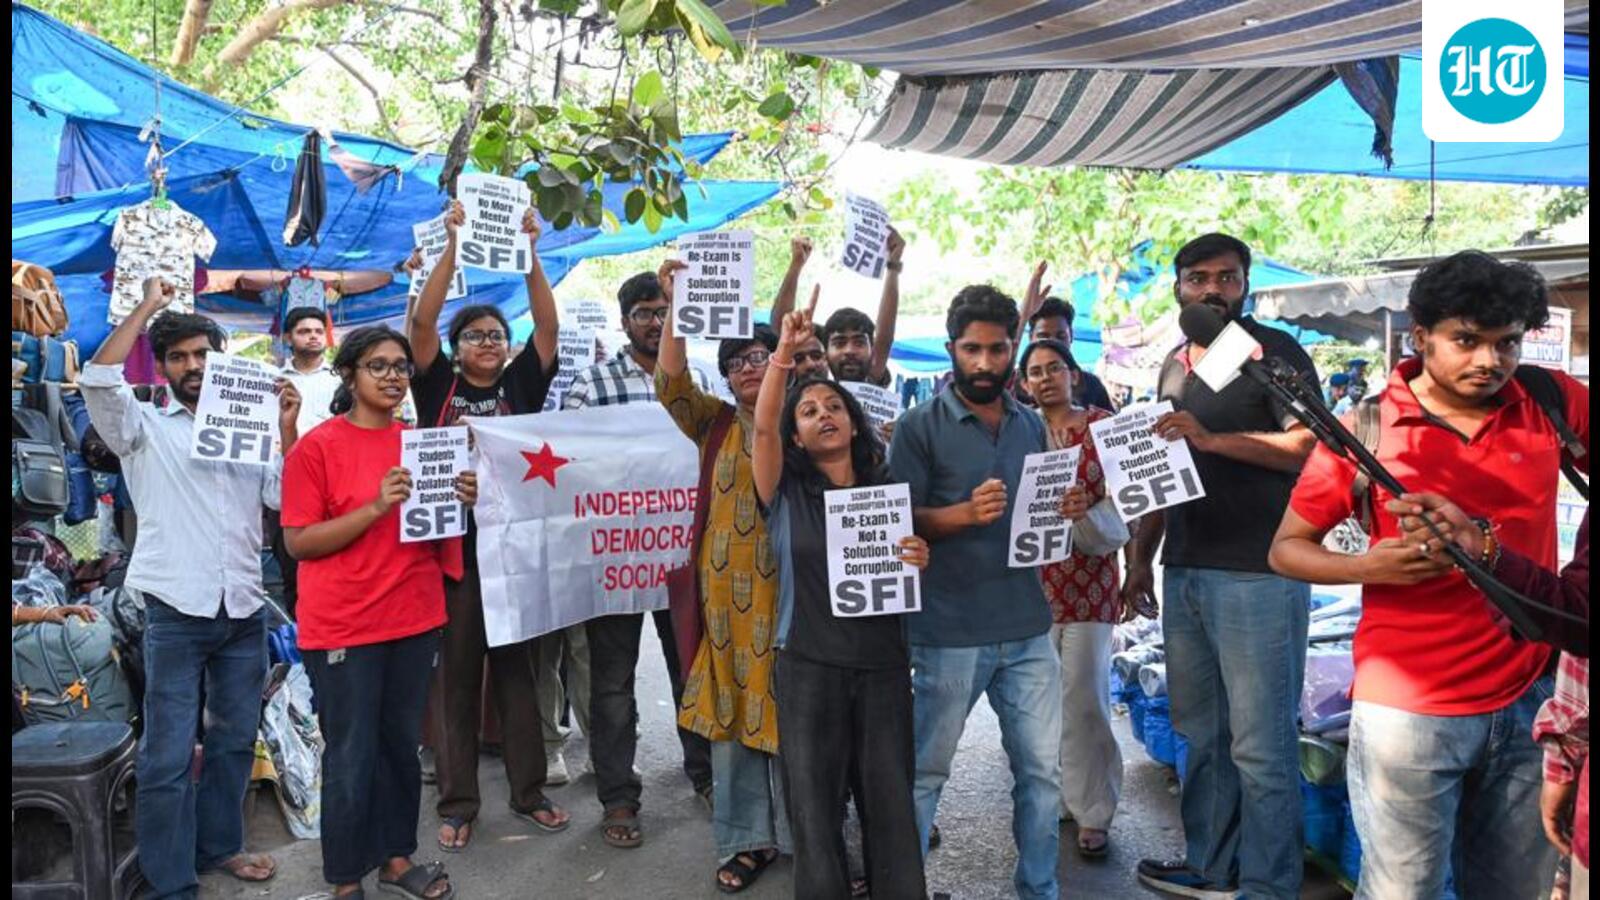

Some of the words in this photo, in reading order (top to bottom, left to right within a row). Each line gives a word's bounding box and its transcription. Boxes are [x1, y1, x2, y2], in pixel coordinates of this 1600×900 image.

[478, 198, 488, 208] No
[491, 200, 513, 213] More
[480, 210, 510, 224] Mental
[472, 220, 501, 233] Torture
[504, 225, 516, 236] for
[472, 232, 514, 246] Aspirants
[461, 241, 525, 270] SFI
[688, 251, 729, 262] Re-Exam
[732, 251, 741, 262] Is
[843, 243, 884, 278] SFI
[702, 265, 717, 275] Not
[720, 266, 726, 275] a
[687, 278, 727, 289] Solution
[730, 278, 740, 288] to
[688, 292, 739, 303] Corruption
[678, 306, 749, 335] SFI
[561, 345, 589, 356] Playing
[212, 374, 234, 388] Stop
[237, 378, 280, 394] Treating
[220, 389, 264, 404] Students
[543, 391, 567, 411] SF
[229, 403, 250, 415] Like
[206, 415, 269, 431] Experiments
[196, 428, 272, 462] SFI
[1104, 434, 1128, 449] Stop
[1130, 428, 1152, 440] Play
[1128, 440, 1152, 455] With
[418, 450, 454, 462] Students
[422, 466, 436, 476] Are
[439, 464, 452, 474] Not
[1128, 461, 1170, 482] Futures
[417, 478, 456, 490] Collatera
[1036, 472, 1072, 486] Students
[420, 492, 454, 504] Damage
[1035, 489, 1050, 499] Are
[1118, 468, 1199, 515] SFI
[574, 488, 698, 518] INDEPENDE
[829, 504, 845, 514] STOP
[847, 501, 885, 512] CORRUPTION
[405, 504, 466, 537] SFI
[842, 513, 888, 528] Re-Exam
[890, 512, 900, 524] Is
[1030, 516, 1064, 528] Damage
[592, 524, 694, 555] DEMOCRA
[859, 530, 876, 542] Not
[880, 530, 886, 541] a
[843, 545, 889, 559] Solution
[1014, 527, 1072, 563] SFI
[844, 560, 903, 576] Corruption
[605, 562, 674, 591] SOCIA
[836, 576, 916, 614] SFI
